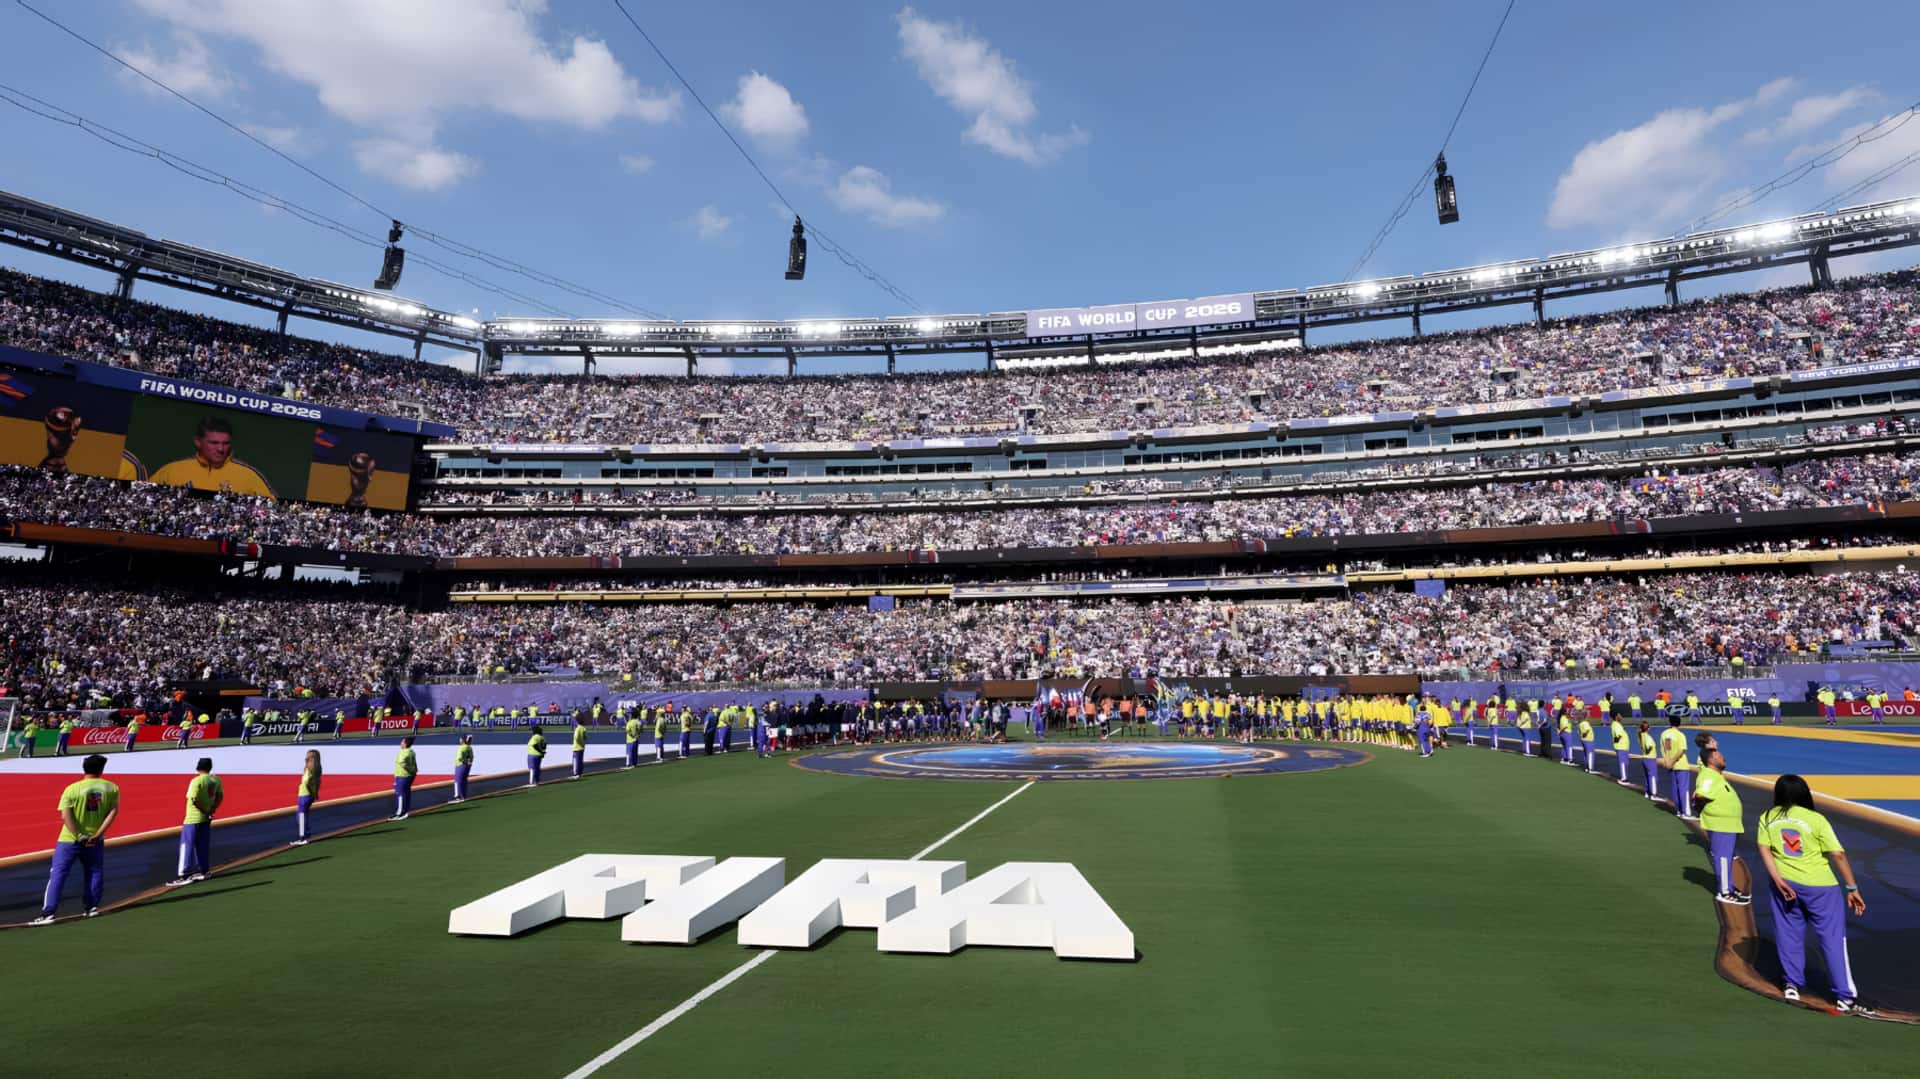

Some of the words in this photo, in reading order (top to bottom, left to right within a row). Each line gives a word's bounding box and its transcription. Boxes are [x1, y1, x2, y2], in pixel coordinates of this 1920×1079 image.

[1038, 315, 1072, 329] FIFA
[1079, 311, 1136, 326] WORLD
[1145, 308, 1177, 321] CUP
[1185, 302, 1242, 318] 2026
[140, 379, 176, 395] FIFA
[179, 386, 237, 405] WORLD
[239, 396, 270, 410] CUP
[271, 403, 322, 419] 2026
[1726, 687, 1756, 697] FIFA
[1696, 704, 1758, 715] HYUNAI
[1850, 702, 1916, 716] Leovo
[267, 722, 319, 734] HYUNAI
[368, 719, 409, 730] Lnovo
[448, 853, 1136, 960] FIFA
